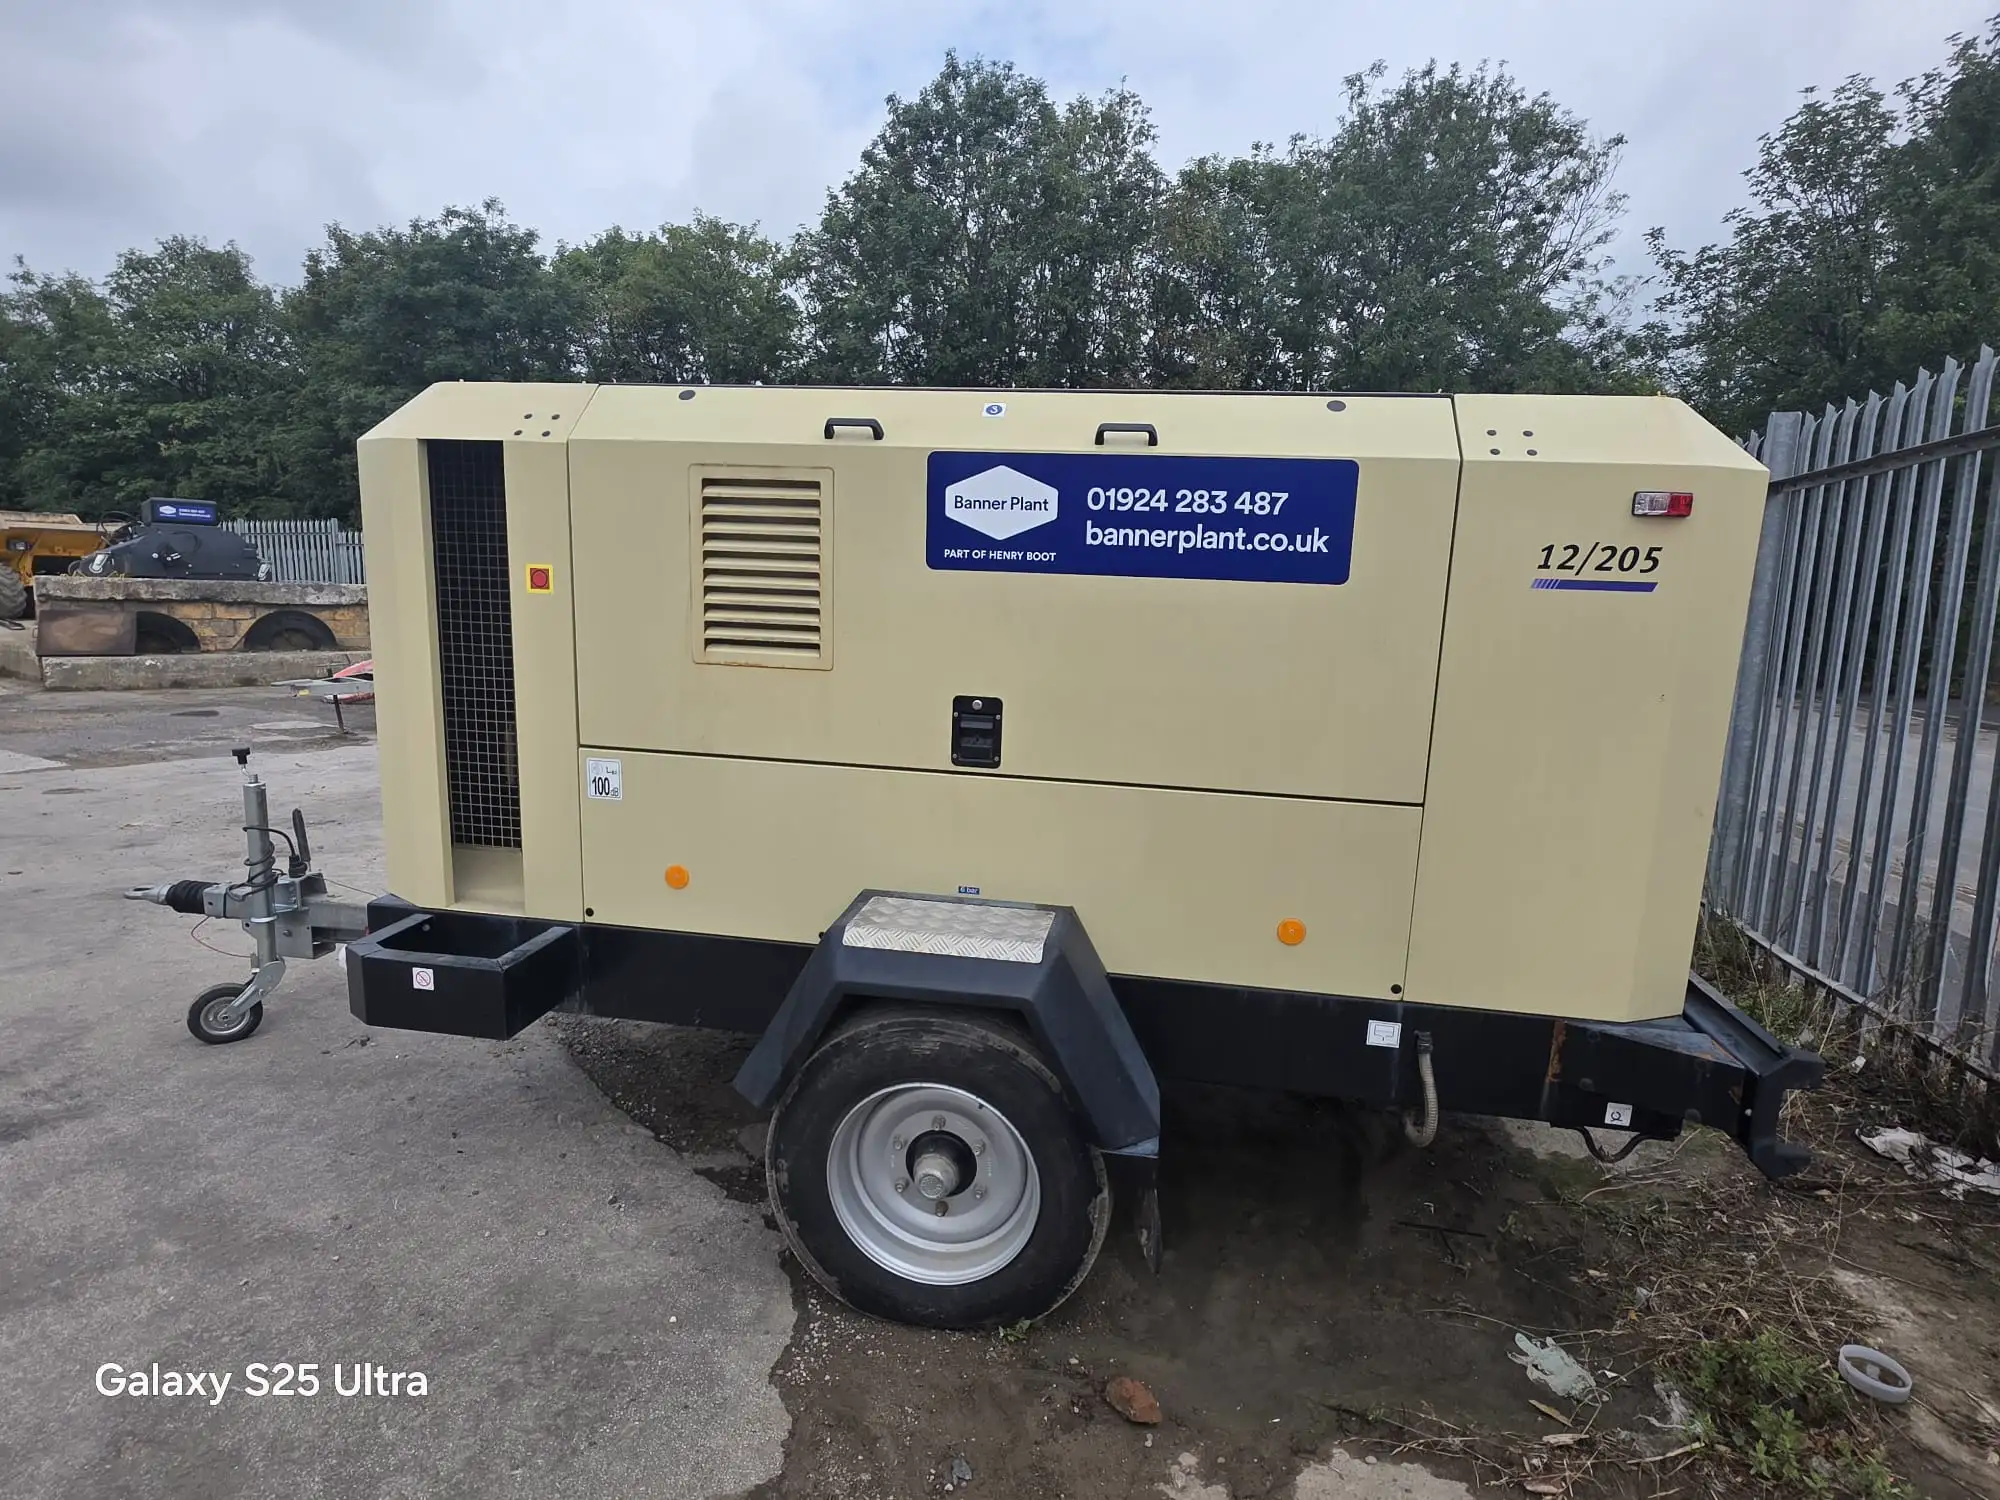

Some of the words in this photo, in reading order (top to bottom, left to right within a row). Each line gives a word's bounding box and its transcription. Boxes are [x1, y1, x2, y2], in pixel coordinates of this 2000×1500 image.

[954, 495, 1007, 510] Banner
[1010, 496, 1049, 511] Plant
[1087, 487, 1168, 512] 01924
[1175, 489, 1228, 514] 283
[1234, 491, 1289, 516] 487
[1086, 520, 1330, 554] bannerplant.co.uk
[944, 548, 970, 559] PART
[972, 549, 987, 559] OF
[989, 550, 1024, 560] HENRY
[1026, 551, 1057, 562] BOOT
[1537, 542, 1664, 576] 12/205
[592, 776, 610, 796] 100
